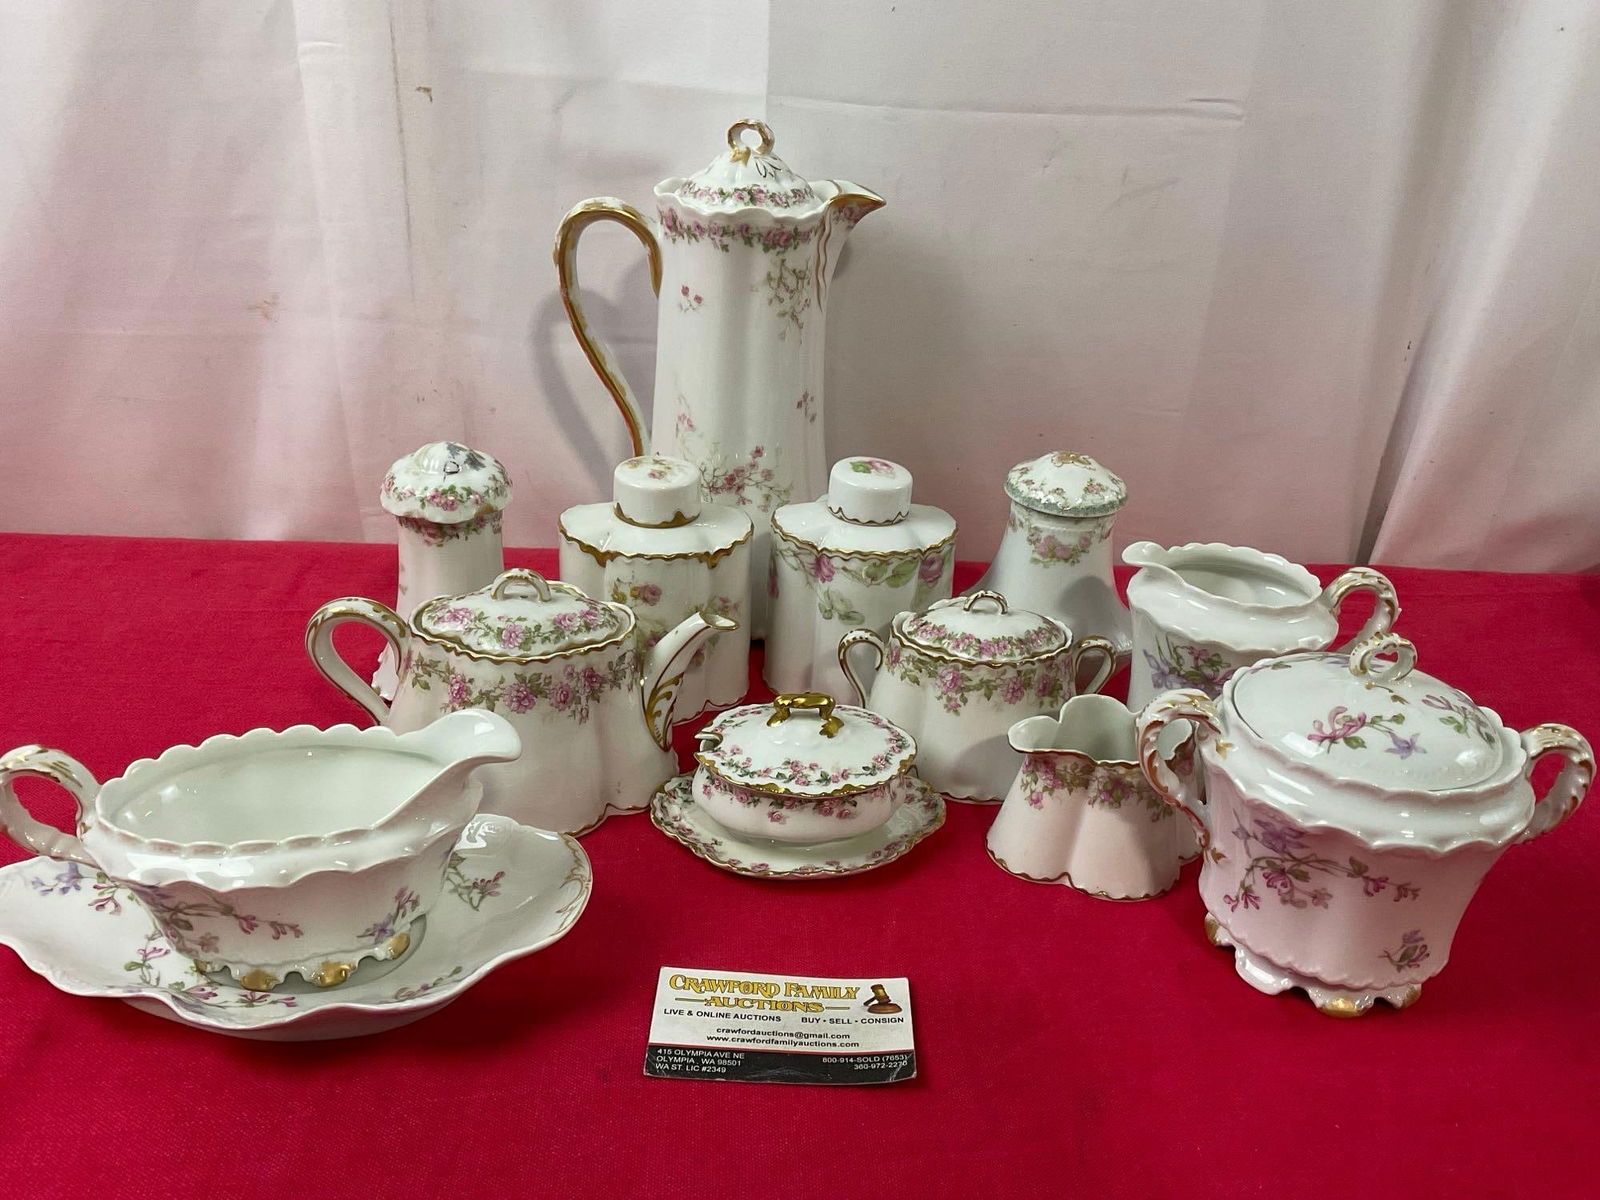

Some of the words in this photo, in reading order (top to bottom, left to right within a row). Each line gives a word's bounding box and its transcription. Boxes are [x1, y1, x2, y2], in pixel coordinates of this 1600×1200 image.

[669, 974, 780, 998] CRAWFORD
[784, 981, 860, 1000] FAMILY
[705, 995, 825, 1013] AUCTIONS
[664, 1008, 684, 1016] LIVE
[696, 1011, 731, 1019] ONLINE
[733, 1013, 781, 1022] AUCTIONS
[716, 1028, 850, 1039] crawfordauctions@gmail.com
[706, 1035, 859, 1047] www.crawfordfamilyauctions.com
[674, 1049, 712, 1058] OLYMPIA
[714, 1051, 731, 1059] AVE
[733, 1052, 745, 1060] NE
